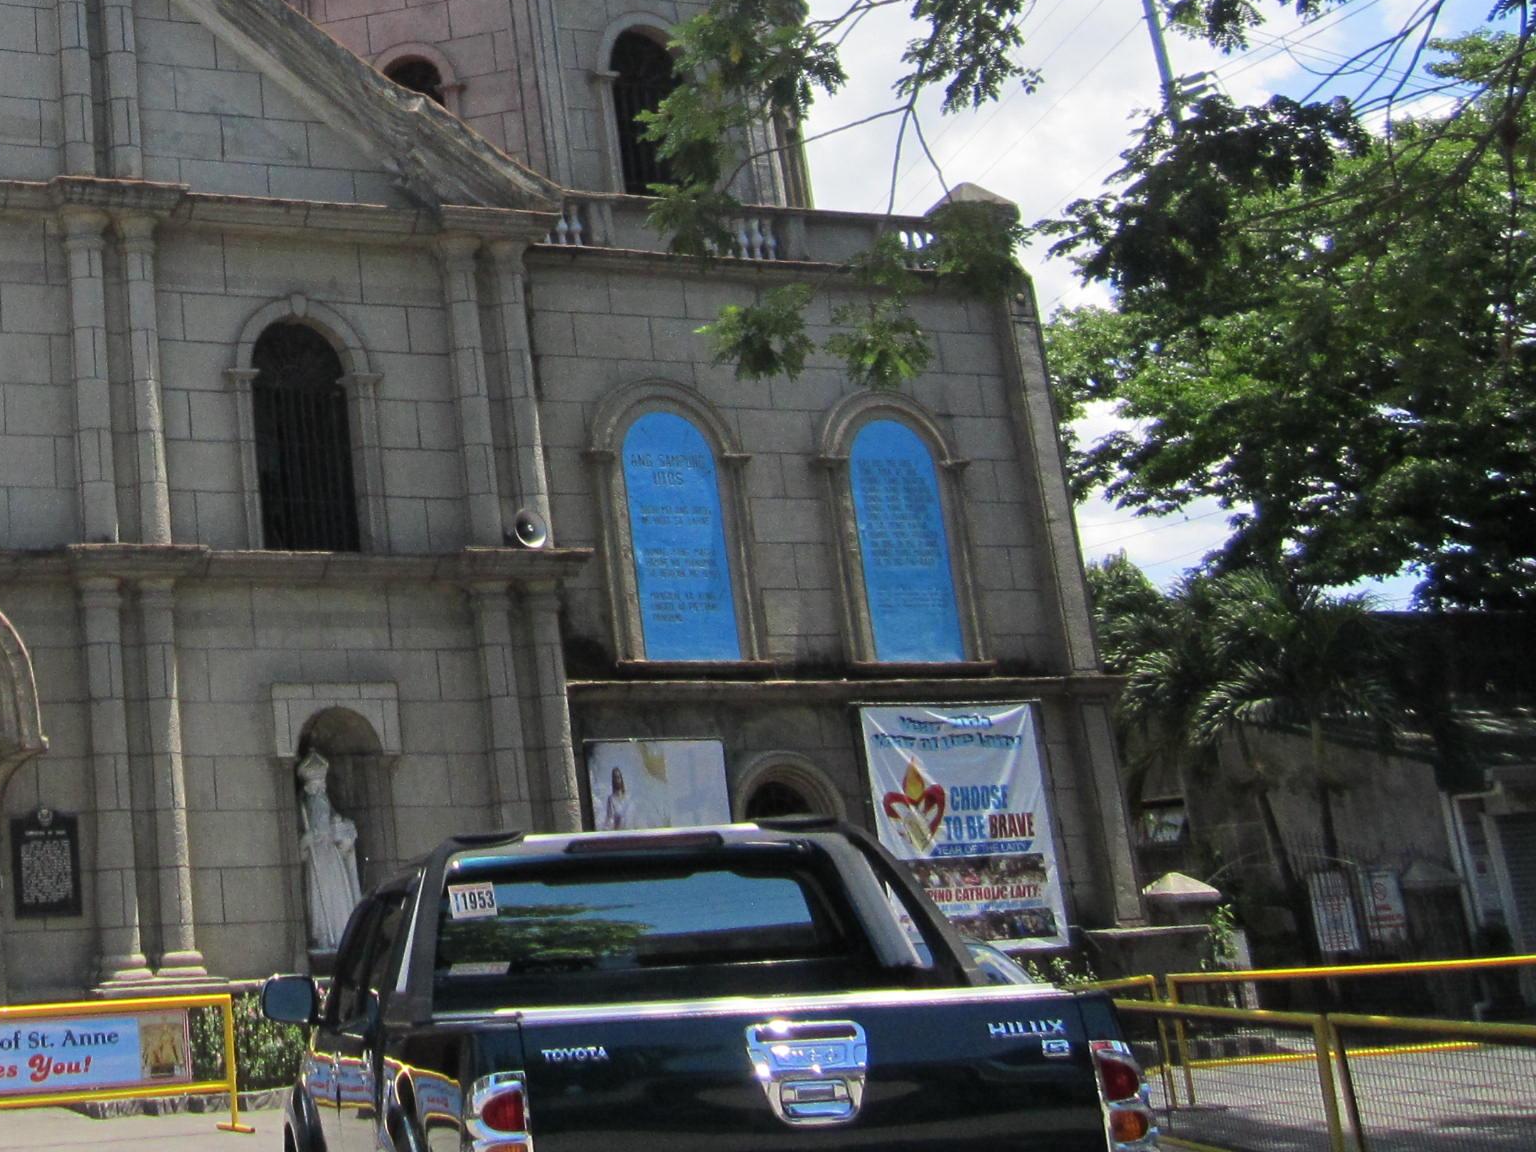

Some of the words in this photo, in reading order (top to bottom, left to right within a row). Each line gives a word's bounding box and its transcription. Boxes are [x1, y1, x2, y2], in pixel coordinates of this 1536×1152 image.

[950, 784, 1009, 811] CHOOSE
[944, 815, 963, 841] TO
[966, 814, 987, 840] BE
[988, 812, 1035, 839] BRAVE
[955, 885, 1008, 901] CATHOLIC
[0, 1030, 22, 1051] of
[28, 1031, 55, 1049] St.
[62, 1029, 119, 1048] Anne
[541, 1046, 609, 1062] TOYOTA
[28, 1053, 92, 1082] You!
